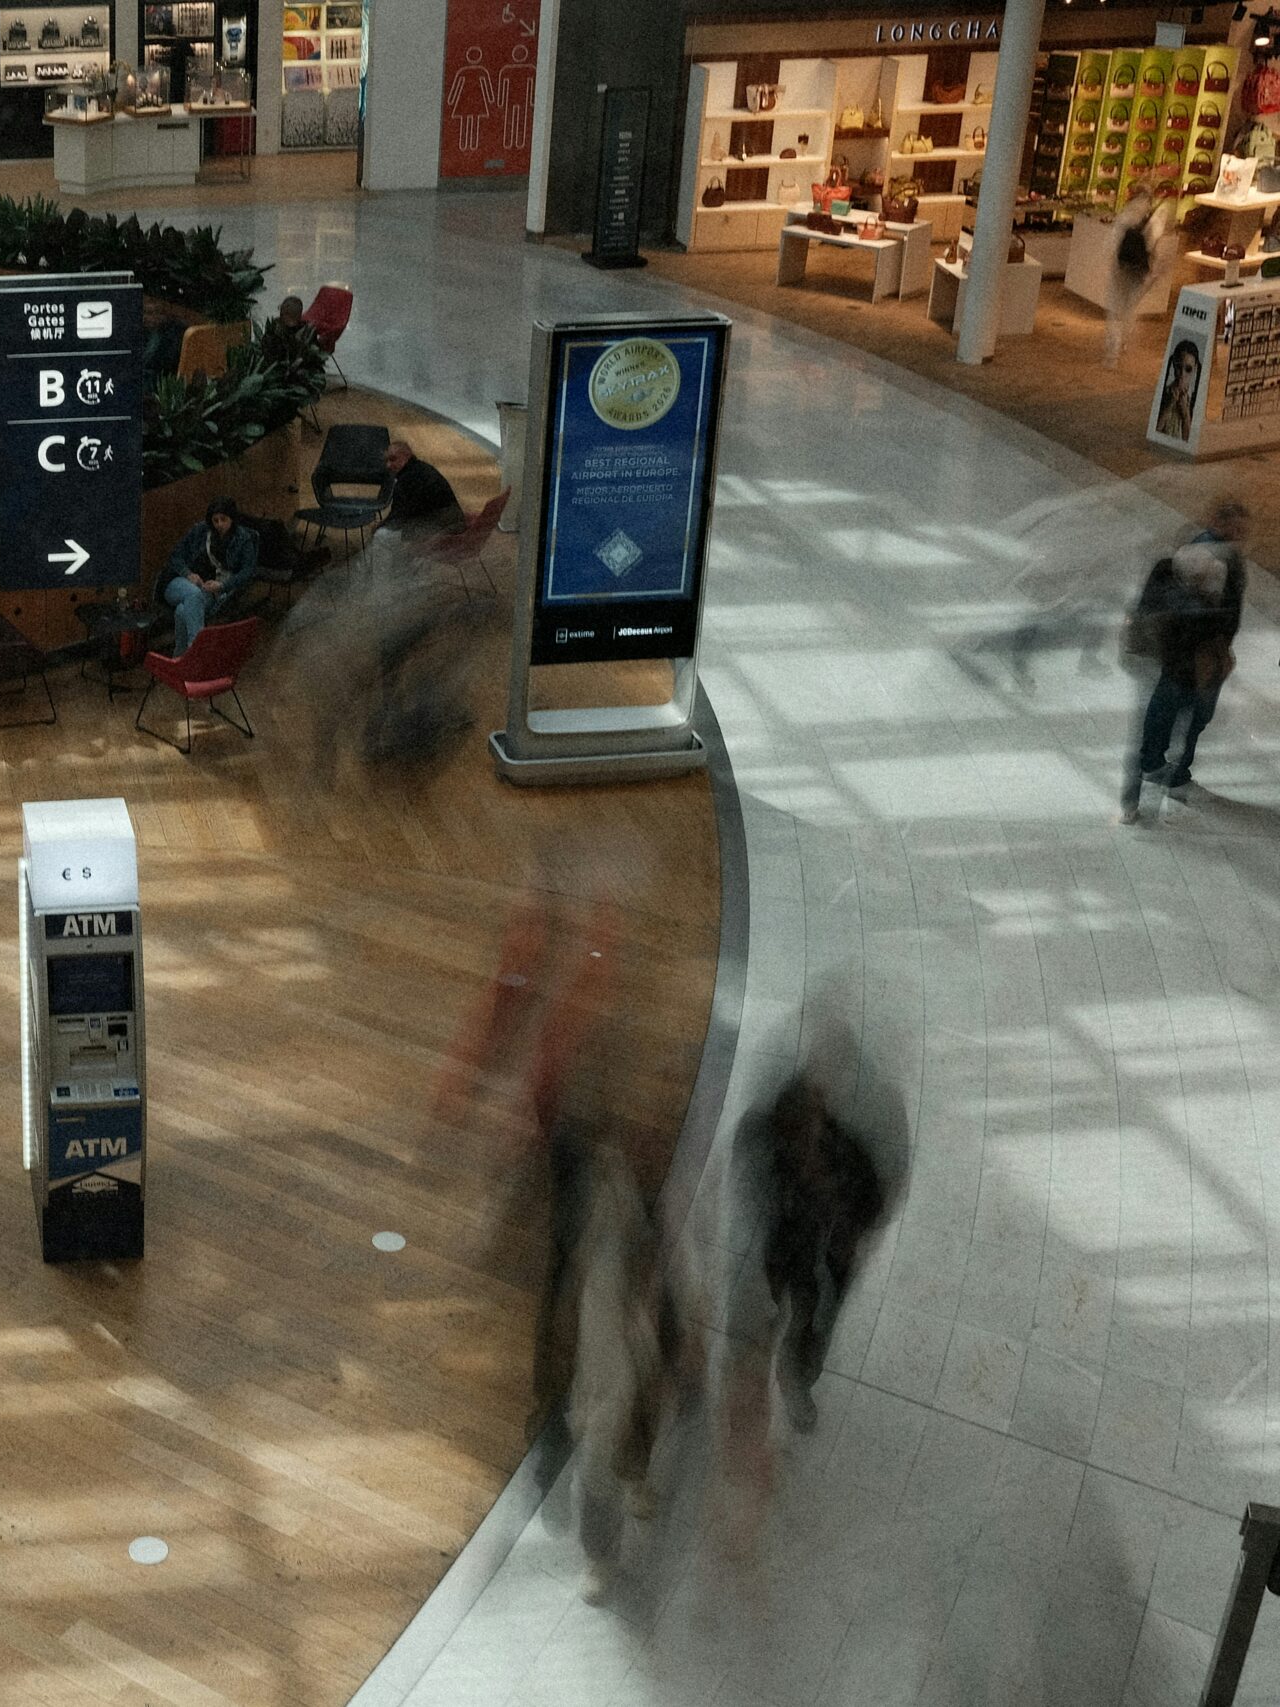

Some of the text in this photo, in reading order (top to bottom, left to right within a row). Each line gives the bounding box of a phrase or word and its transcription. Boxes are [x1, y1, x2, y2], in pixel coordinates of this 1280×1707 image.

[23, 302, 65, 315] Portes
[28, 315, 65, 327] Gates
[597, 345, 666, 385] WORLD AIRPORT
[39, 369, 100, 408] B 11
[607, 406, 650, 422] AWARDS
[37, 434, 98, 473] C 7
[584, 456, 670, 468] BEST REGIONAL
[571, 470, 617, 480] AIRPORT
[621, 469, 633, 479] IN
[576, 484, 673, 495] MEJOR AEROPUERTO
[571, 493, 674, 505] REGIONAL DE EUROPA
[61, 867, 72, 881] €
[62, 912, 117, 938] ATM
[64, 1136, 128, 1160] ATM
